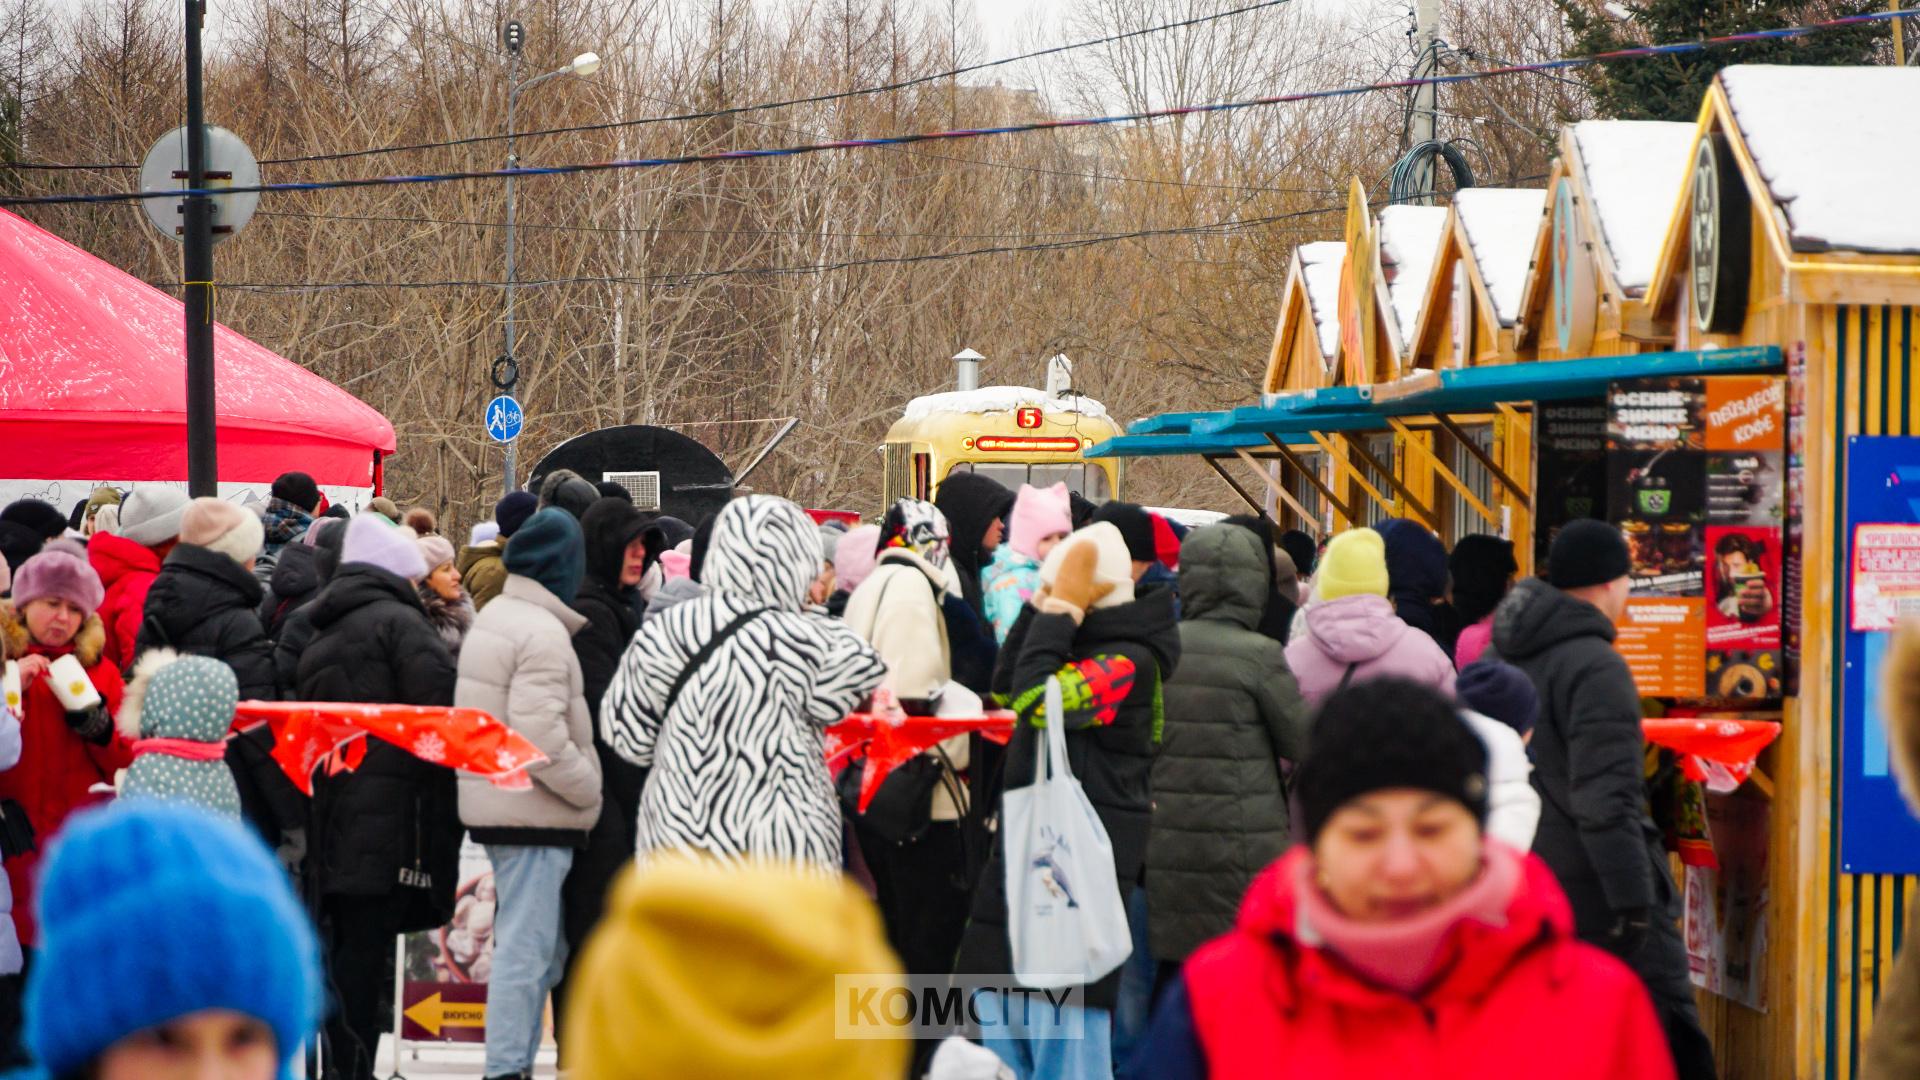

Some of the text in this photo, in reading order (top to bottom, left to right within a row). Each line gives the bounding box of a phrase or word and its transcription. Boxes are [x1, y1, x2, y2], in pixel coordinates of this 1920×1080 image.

[1024, 409, 1036, 427] 5
[1616, 408, 1689, 424] ЗИМНЕЕ
[1623, 425, 1681, 440] МЕНЮ
[1733, 414, 1775, 443] КОФЕ
[442, 1010, 483, 1020] ВКУСНО
